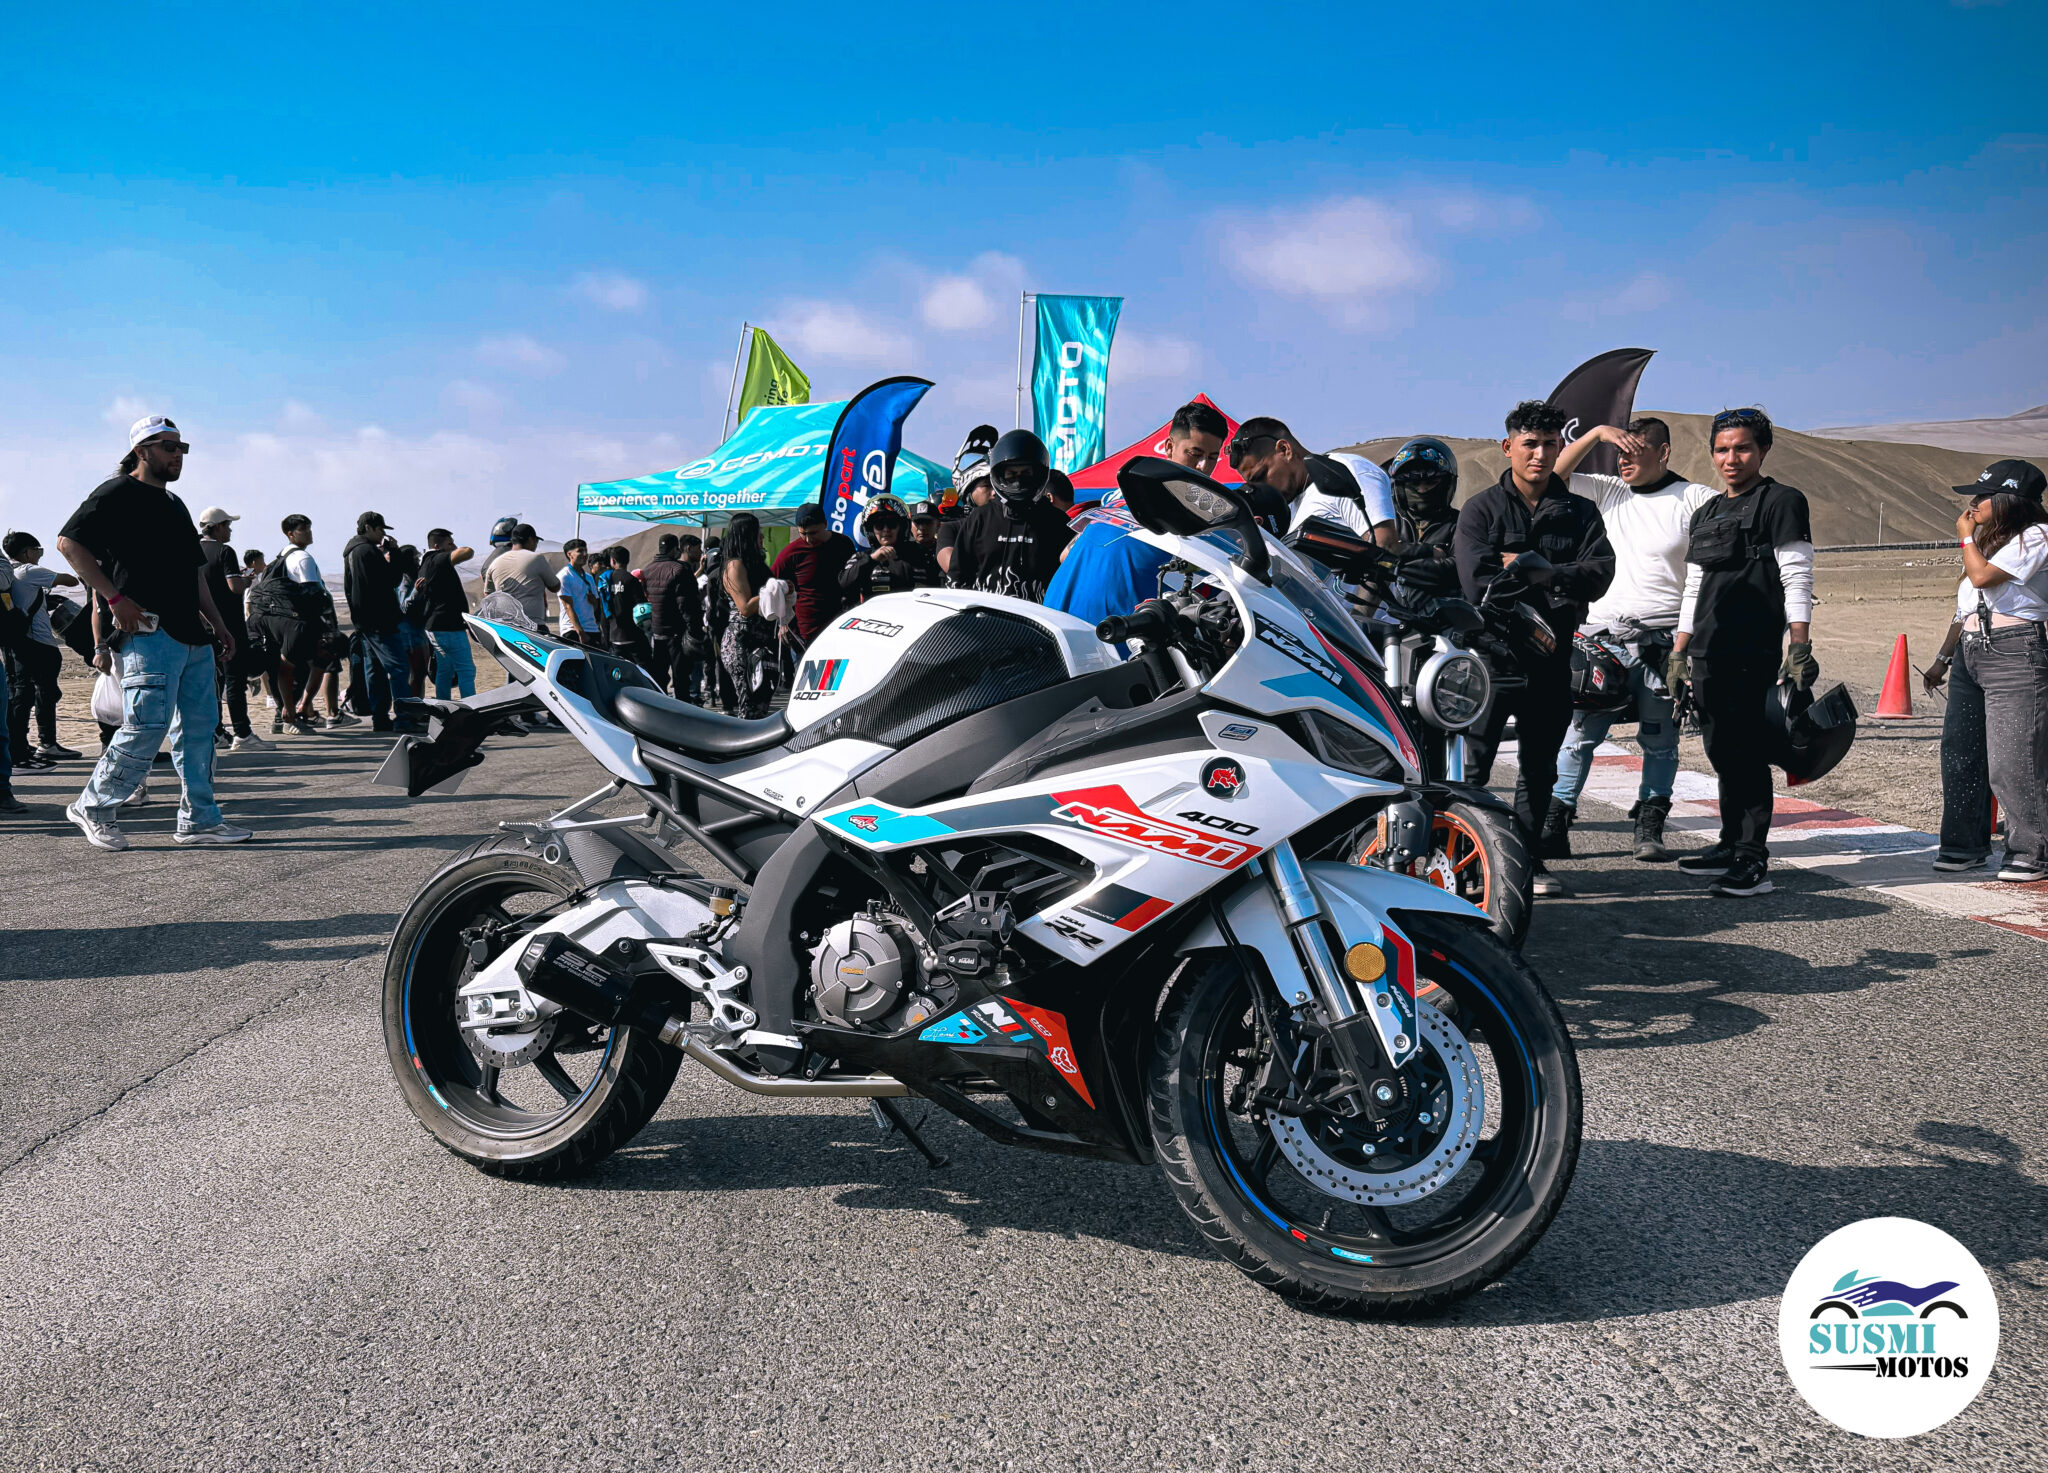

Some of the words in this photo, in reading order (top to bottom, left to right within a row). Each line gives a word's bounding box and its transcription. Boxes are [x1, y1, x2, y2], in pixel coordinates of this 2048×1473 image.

[720, 444, 830, 472] CFMOT
[583, 492, 658, 510] experience
[662, 493, 699, 506] more
[703, 488, 767, 509] together
[830, 446, 857, 534] otopart
[793, 691, 821, 701] 400
[1176, 811, 1260, 836] 400
[1042, 919, 1107, 951] RR
[560, 950, 612, 981] SC
